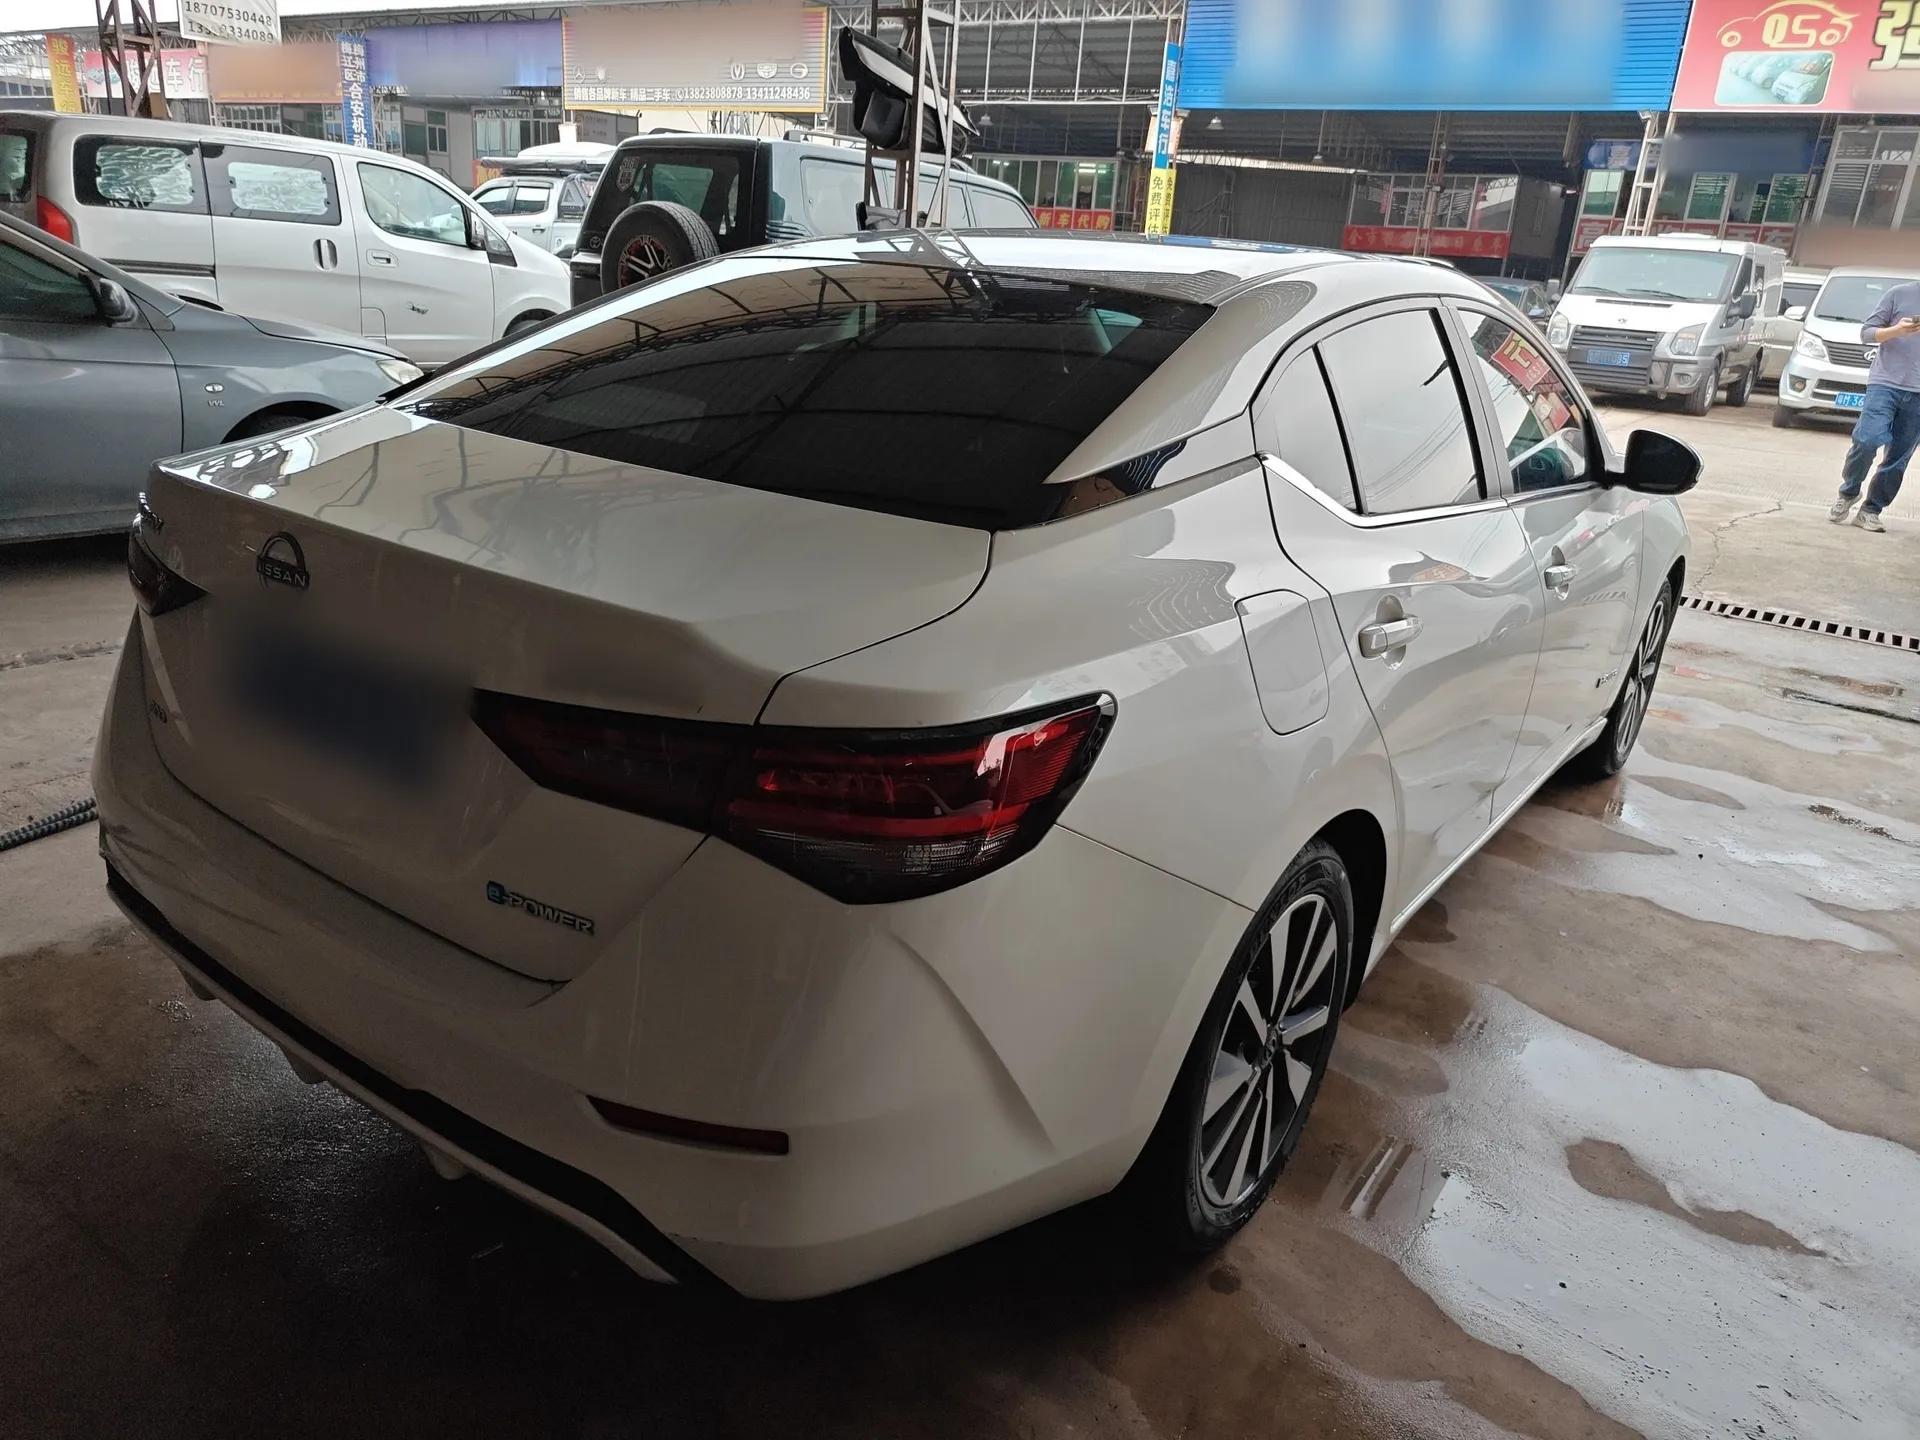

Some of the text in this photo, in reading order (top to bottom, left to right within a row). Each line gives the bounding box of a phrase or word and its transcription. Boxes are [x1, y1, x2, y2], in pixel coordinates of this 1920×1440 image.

[185, 1, 272, 26] 18707530448
[188, 20, 274, 43] 13334089
[630, 87, 671, 101] 精品二手车
[684, 86, 743, 99] 13823808878
[746, 86, 810, 100] 13411248436
